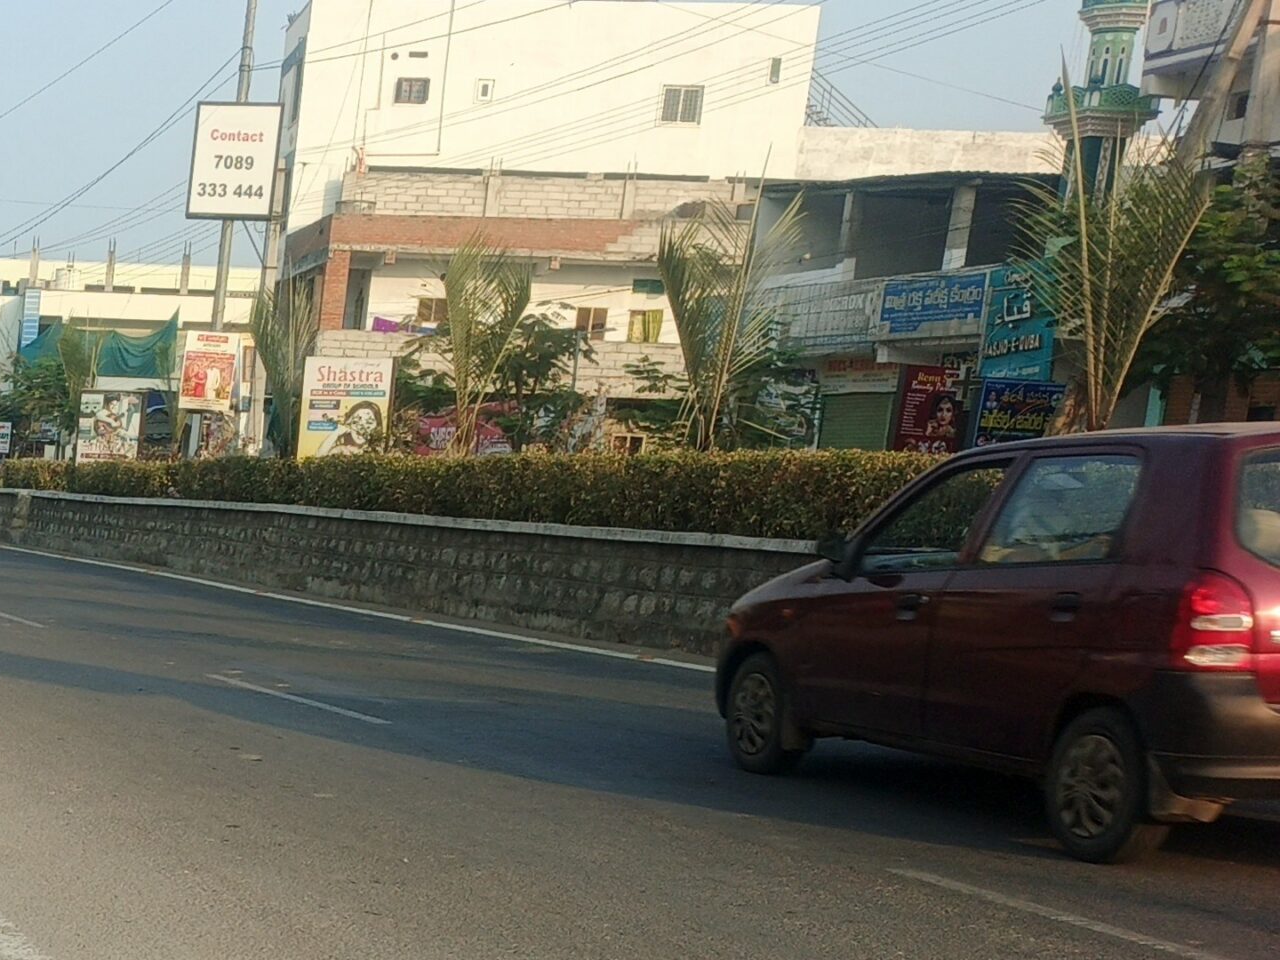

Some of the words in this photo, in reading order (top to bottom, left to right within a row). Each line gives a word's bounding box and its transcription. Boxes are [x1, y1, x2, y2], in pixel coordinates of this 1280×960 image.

[210, 129, 264, 142] Contact
[214, 155, 254, 170] 7089
[197, 183, 227, 197] 333
[233, 184, 264, 199] 444
[317, 366, 383, 383] Shastra
